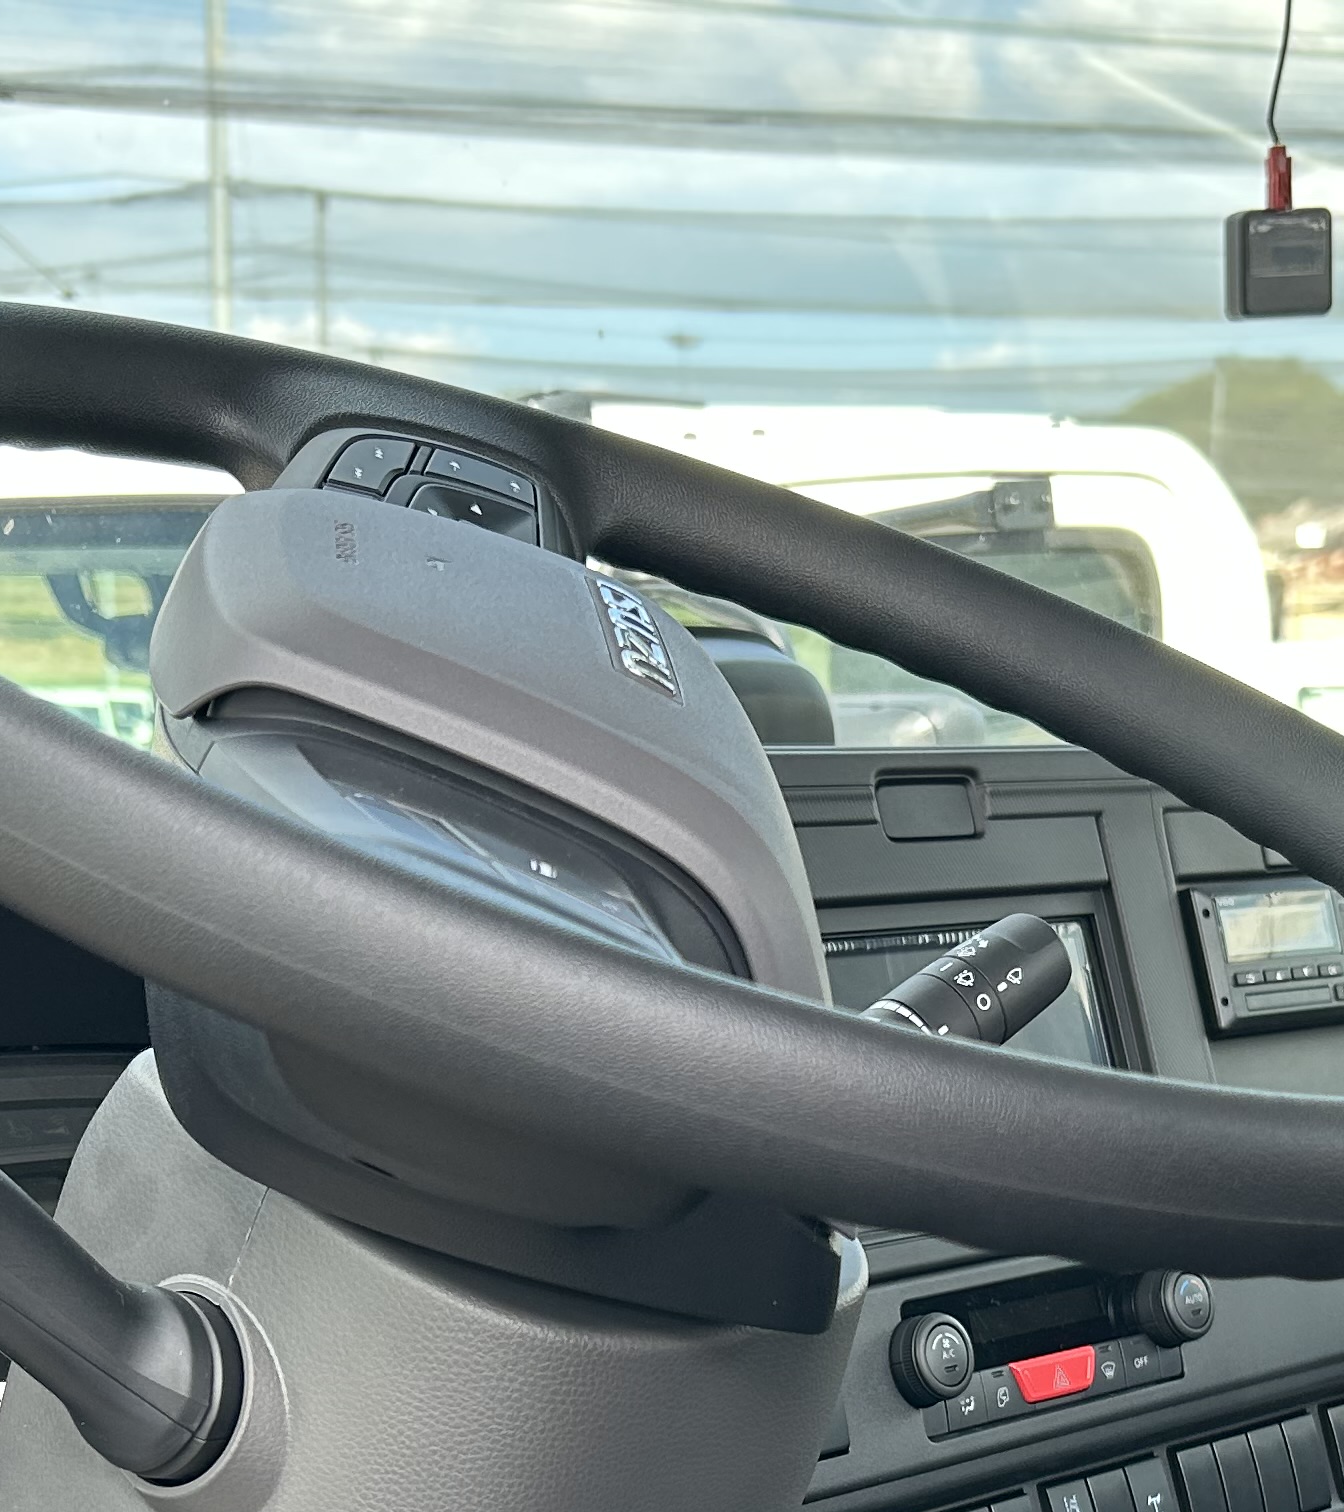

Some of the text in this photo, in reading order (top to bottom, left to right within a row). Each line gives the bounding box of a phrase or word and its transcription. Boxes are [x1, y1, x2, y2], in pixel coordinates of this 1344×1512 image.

[596, 579, 677, 697] ISUZU
[1185, 1292, 1203, 1304] AUTO
[1134, 1355, 1148, 1369] OFF
